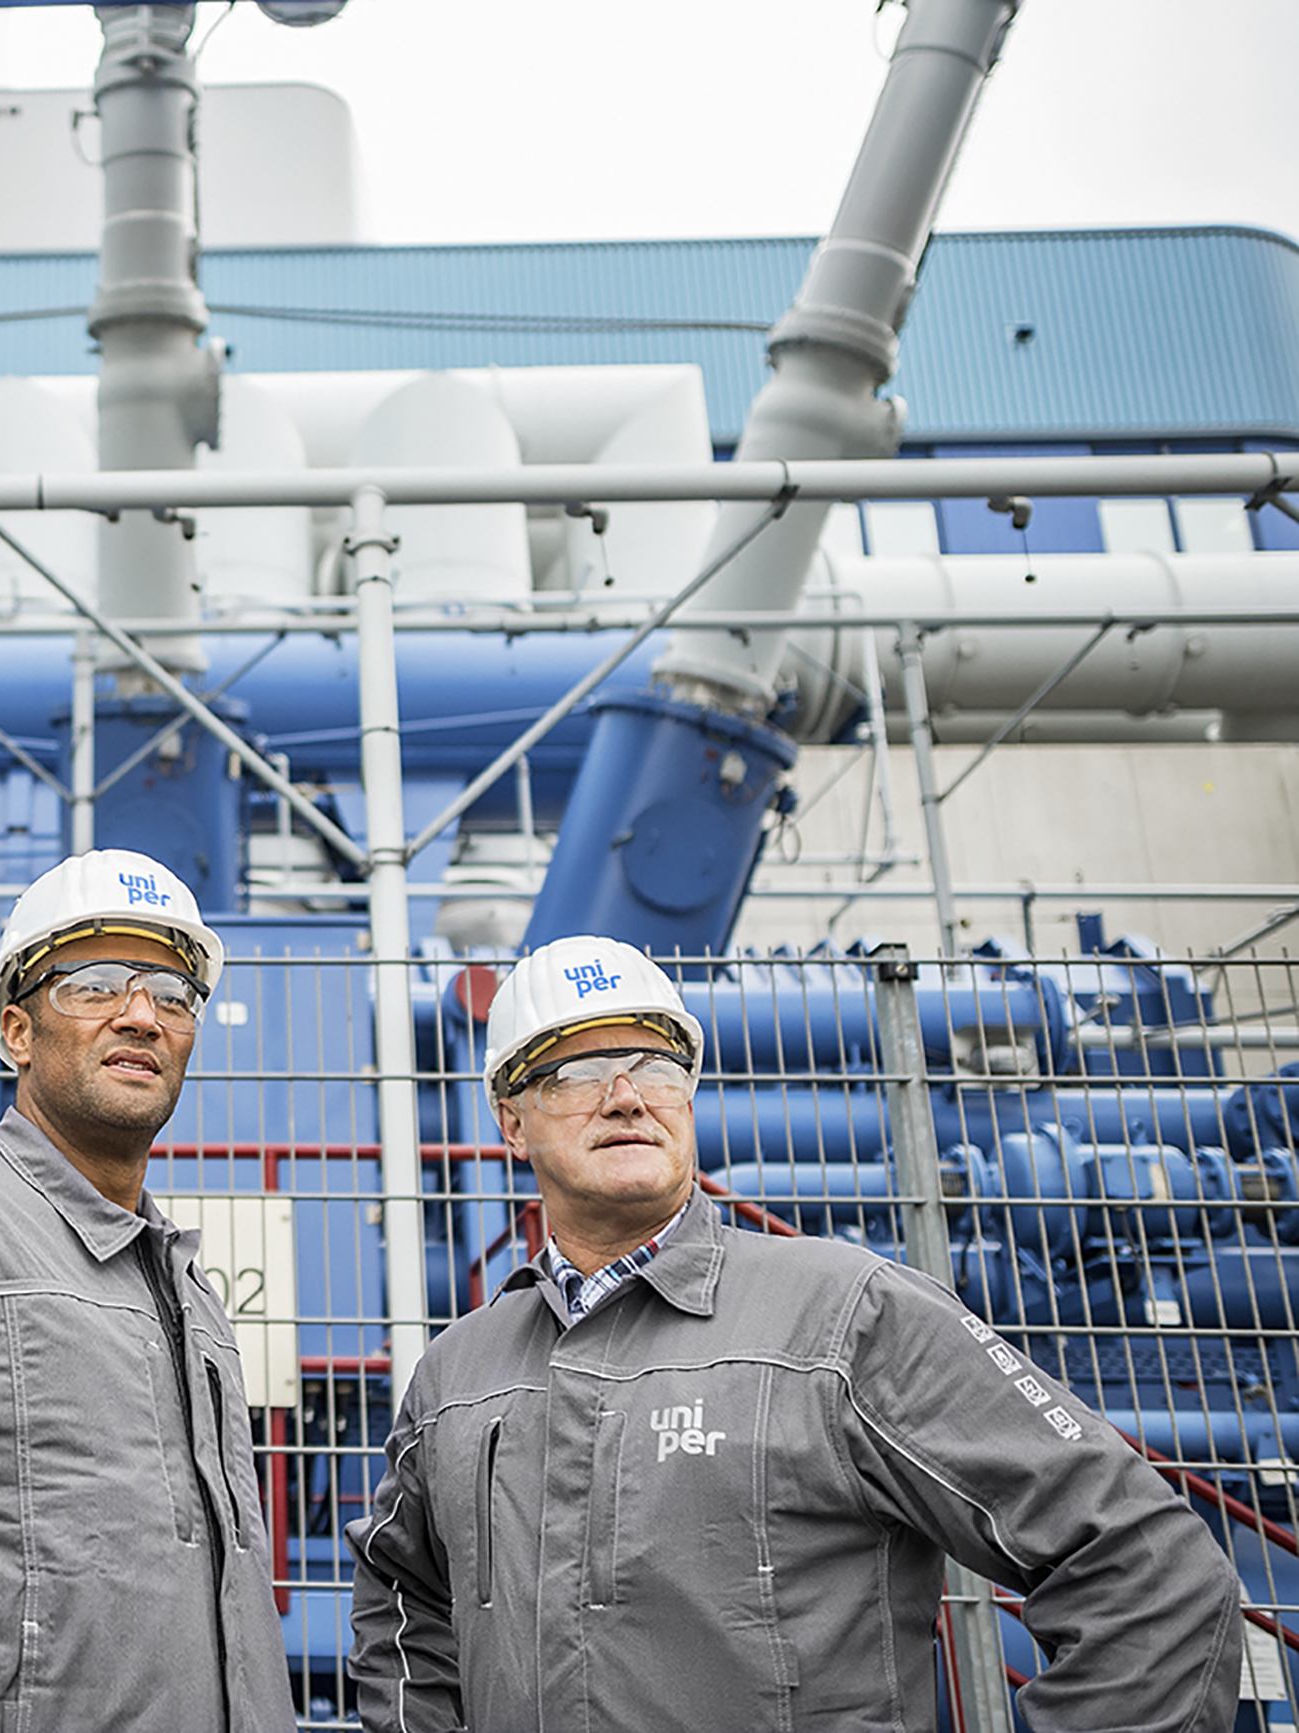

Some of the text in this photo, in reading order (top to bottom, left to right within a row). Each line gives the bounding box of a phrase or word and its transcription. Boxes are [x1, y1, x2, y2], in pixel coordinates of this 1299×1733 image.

[119, 873, 156, 891] uni
[128, 887, 171, 906] per
[564, 959, 604, 981] uni
[575, 975, 622, 998] per
[650, 1398, 704, 1431] uni
[657, 1429, 726, 1462] per
